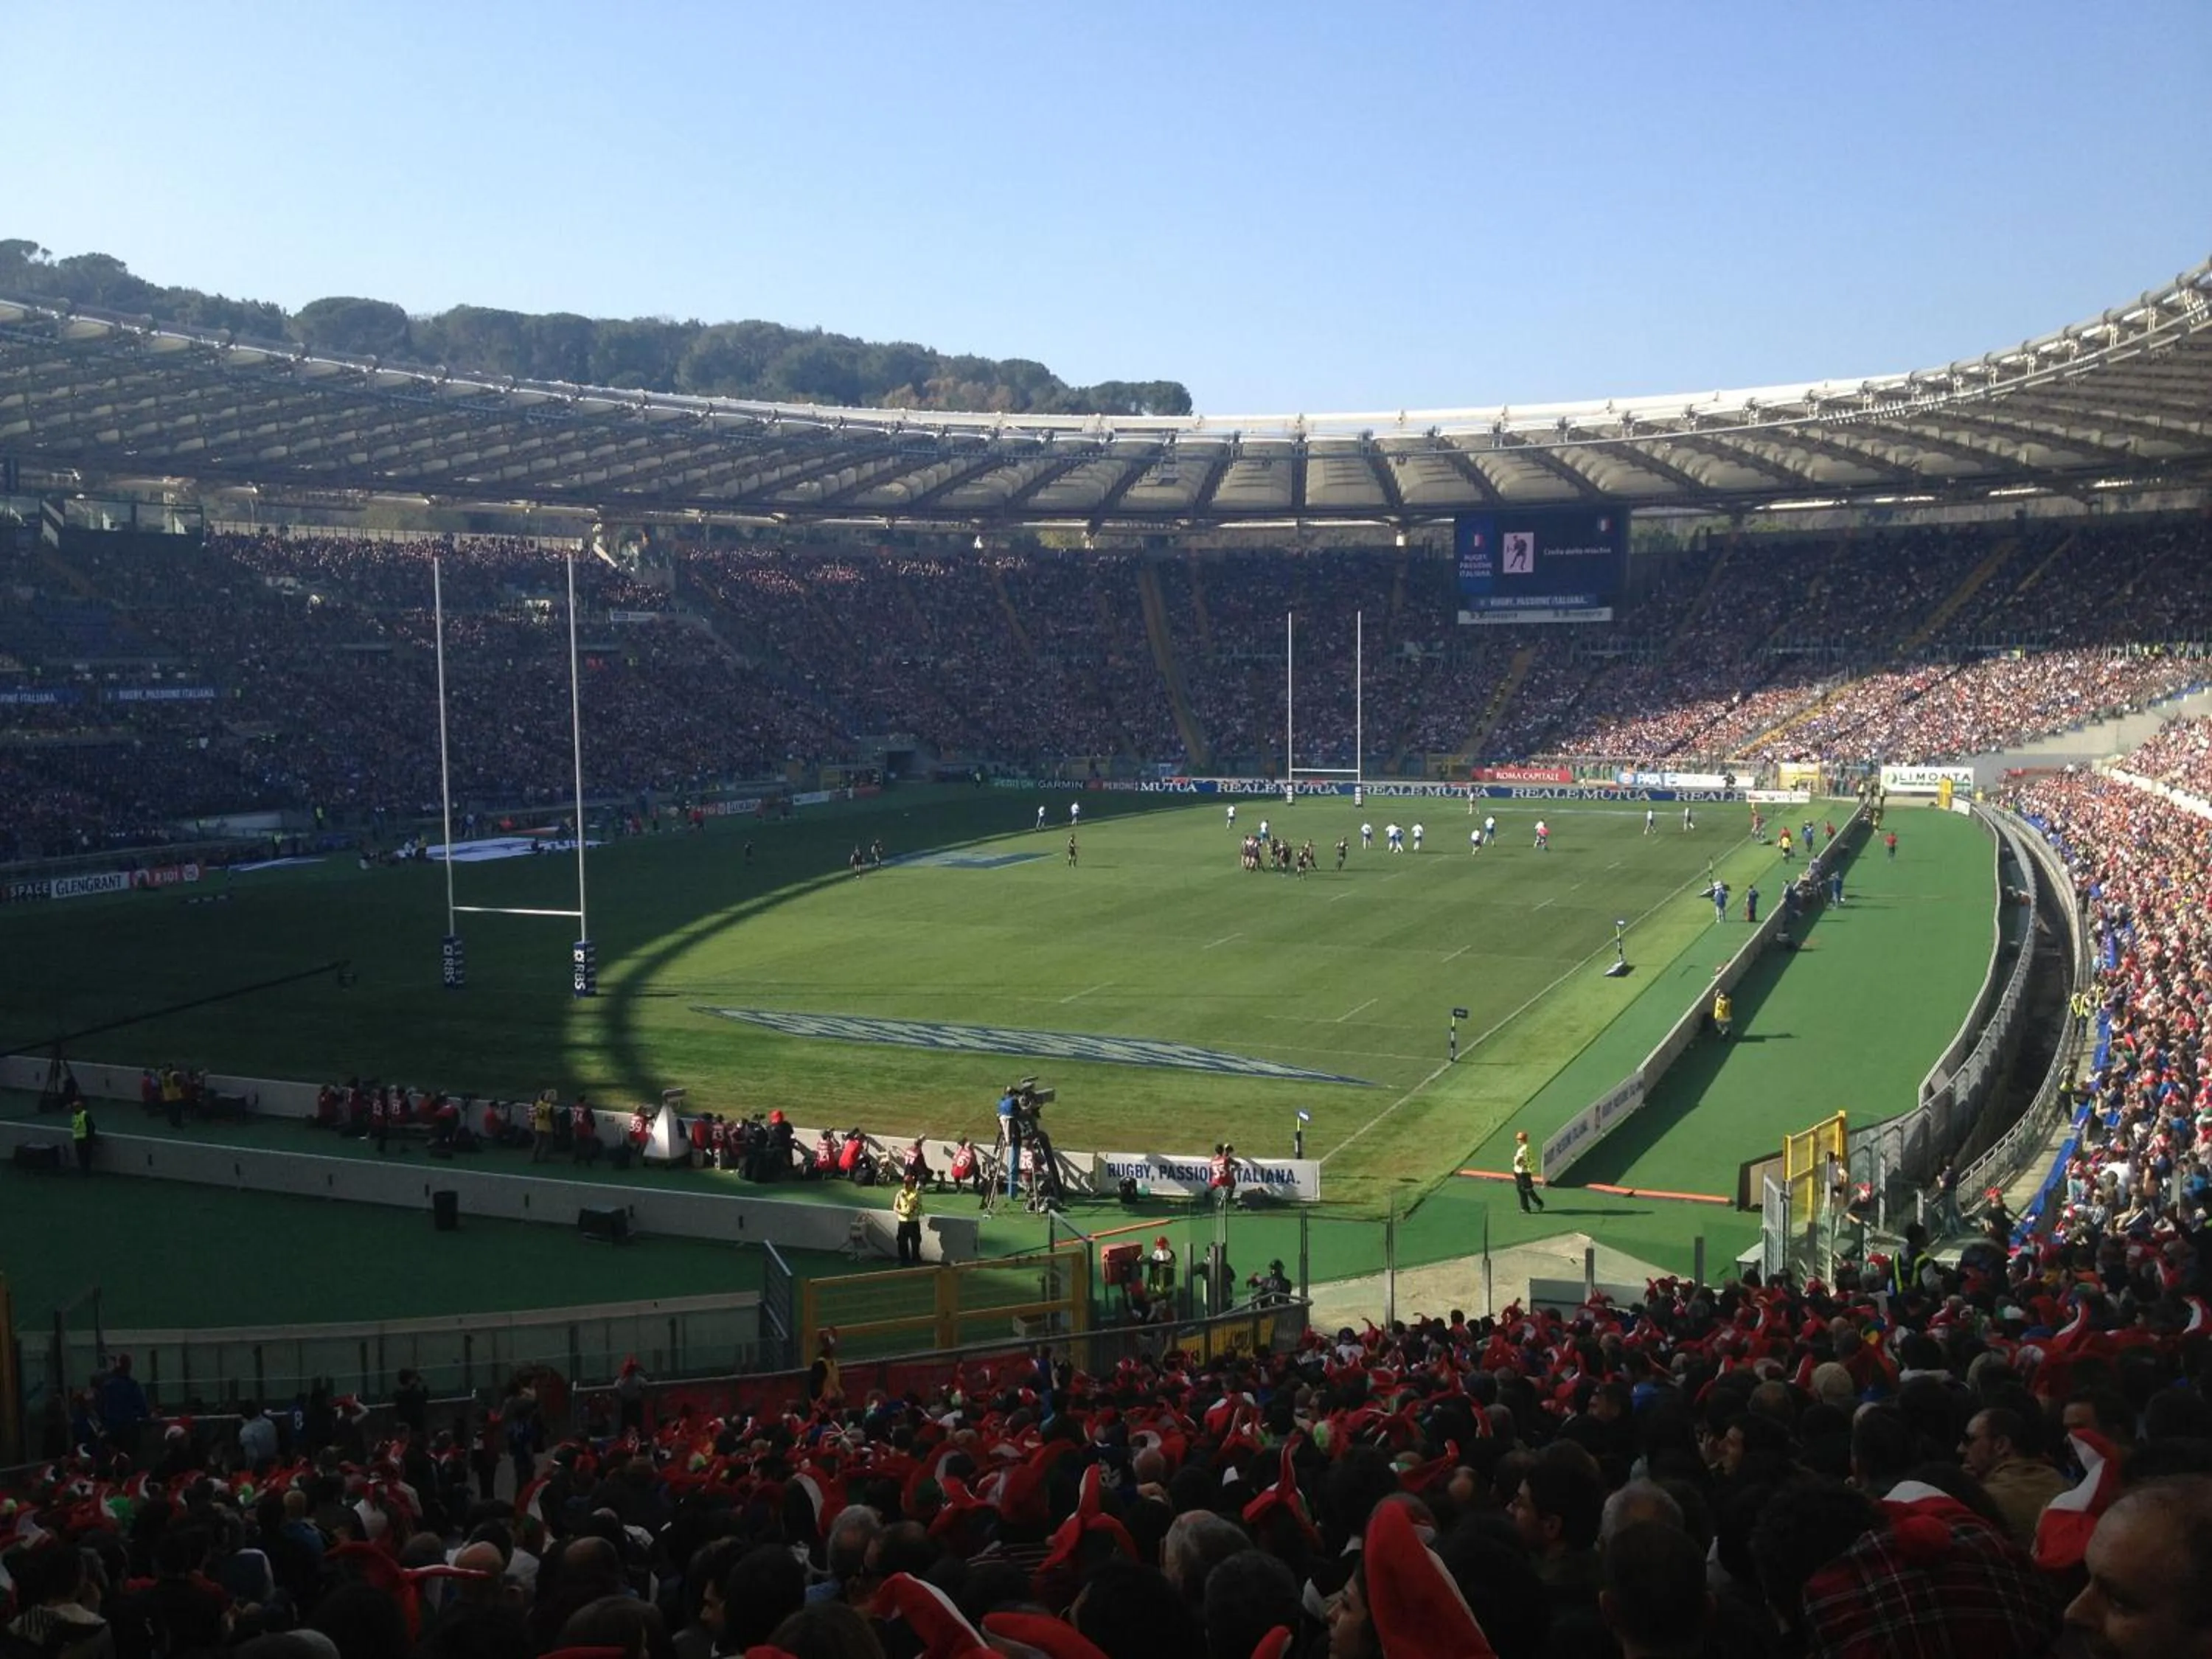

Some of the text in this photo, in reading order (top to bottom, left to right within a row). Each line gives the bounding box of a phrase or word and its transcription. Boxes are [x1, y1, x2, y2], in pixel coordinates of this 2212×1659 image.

[1495, 771, 1560, 782] ROMA CAPITALE
[1899, 772, 1971, 782] LIMONTA
[1037, 779, 1084, 790] GARMIN
[1141, 781, 1197, 793] MUTUA
[1217, 782, 1276, 794] REALE
[1423, 785, 1489, 798] MUTUA
[1512, 787, 1652, 801] REALE MUTUA
[1674, 790, 1744, 802] REALE
[10, 883, 50, 897] SPACE
[574, 964, 585, 990] RBS
[1107, 1162, 1301, 1185] RUGBY, PASSIO TALIANA.
[293, 1410, 304, 1430] 8
